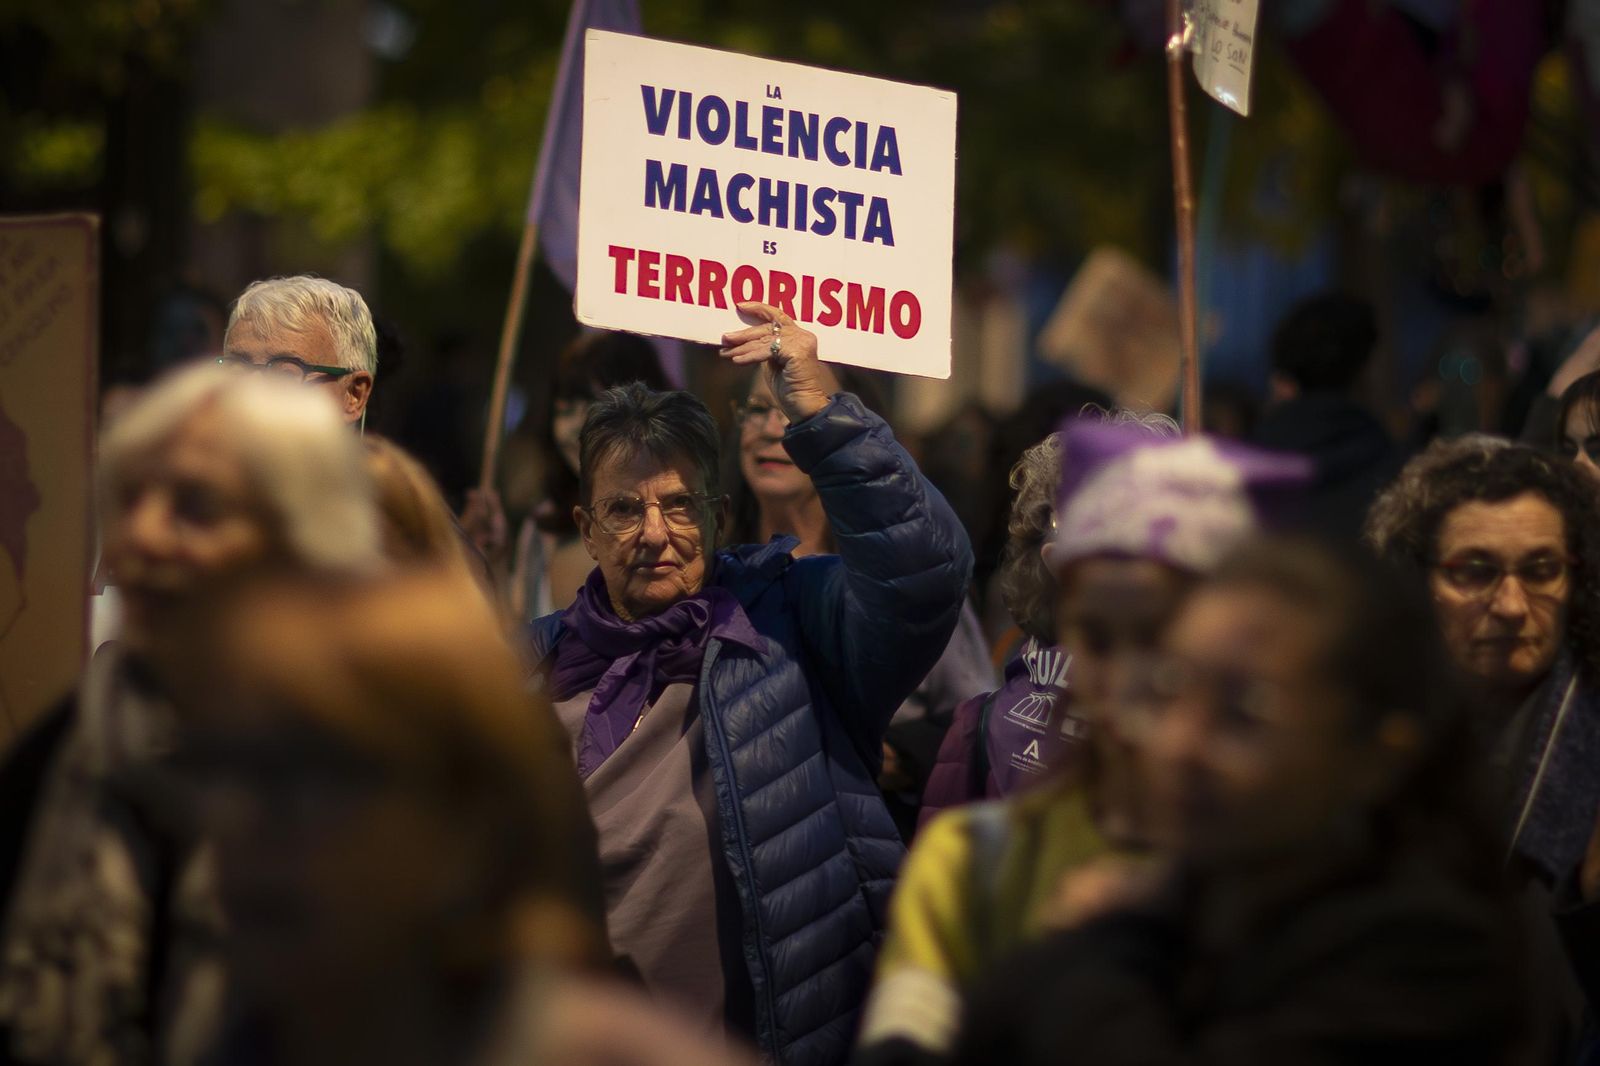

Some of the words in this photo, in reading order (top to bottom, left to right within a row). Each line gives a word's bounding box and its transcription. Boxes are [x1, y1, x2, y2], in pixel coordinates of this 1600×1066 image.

[640, 84, 903, 176] VIOLENCIA
[765, 84, 782, 100] LA
[644, 158, 895, 247] MACHISTA
[608, 244, 922, 340] TERRORISMO
[763, 240, 777, 255] ES
